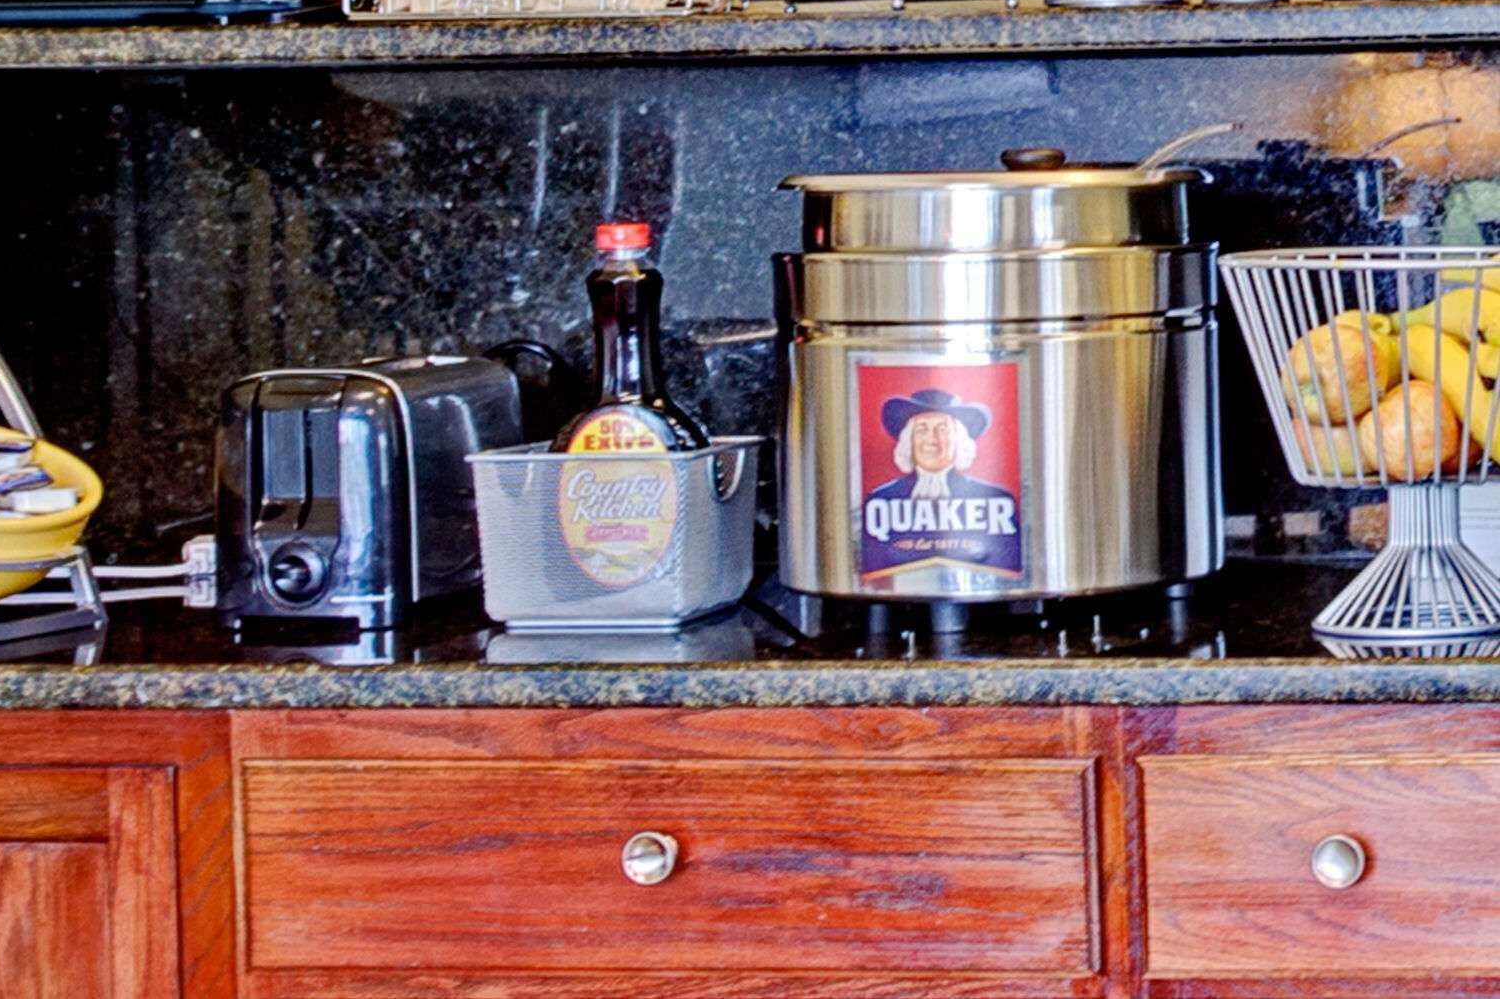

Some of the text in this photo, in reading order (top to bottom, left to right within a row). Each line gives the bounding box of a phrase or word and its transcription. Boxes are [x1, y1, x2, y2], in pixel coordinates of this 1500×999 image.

[567, 469, 666, 504] Country
[572, 497, 662, 523] Kitchen
[865, 497, 1017, 541] QUAKER
